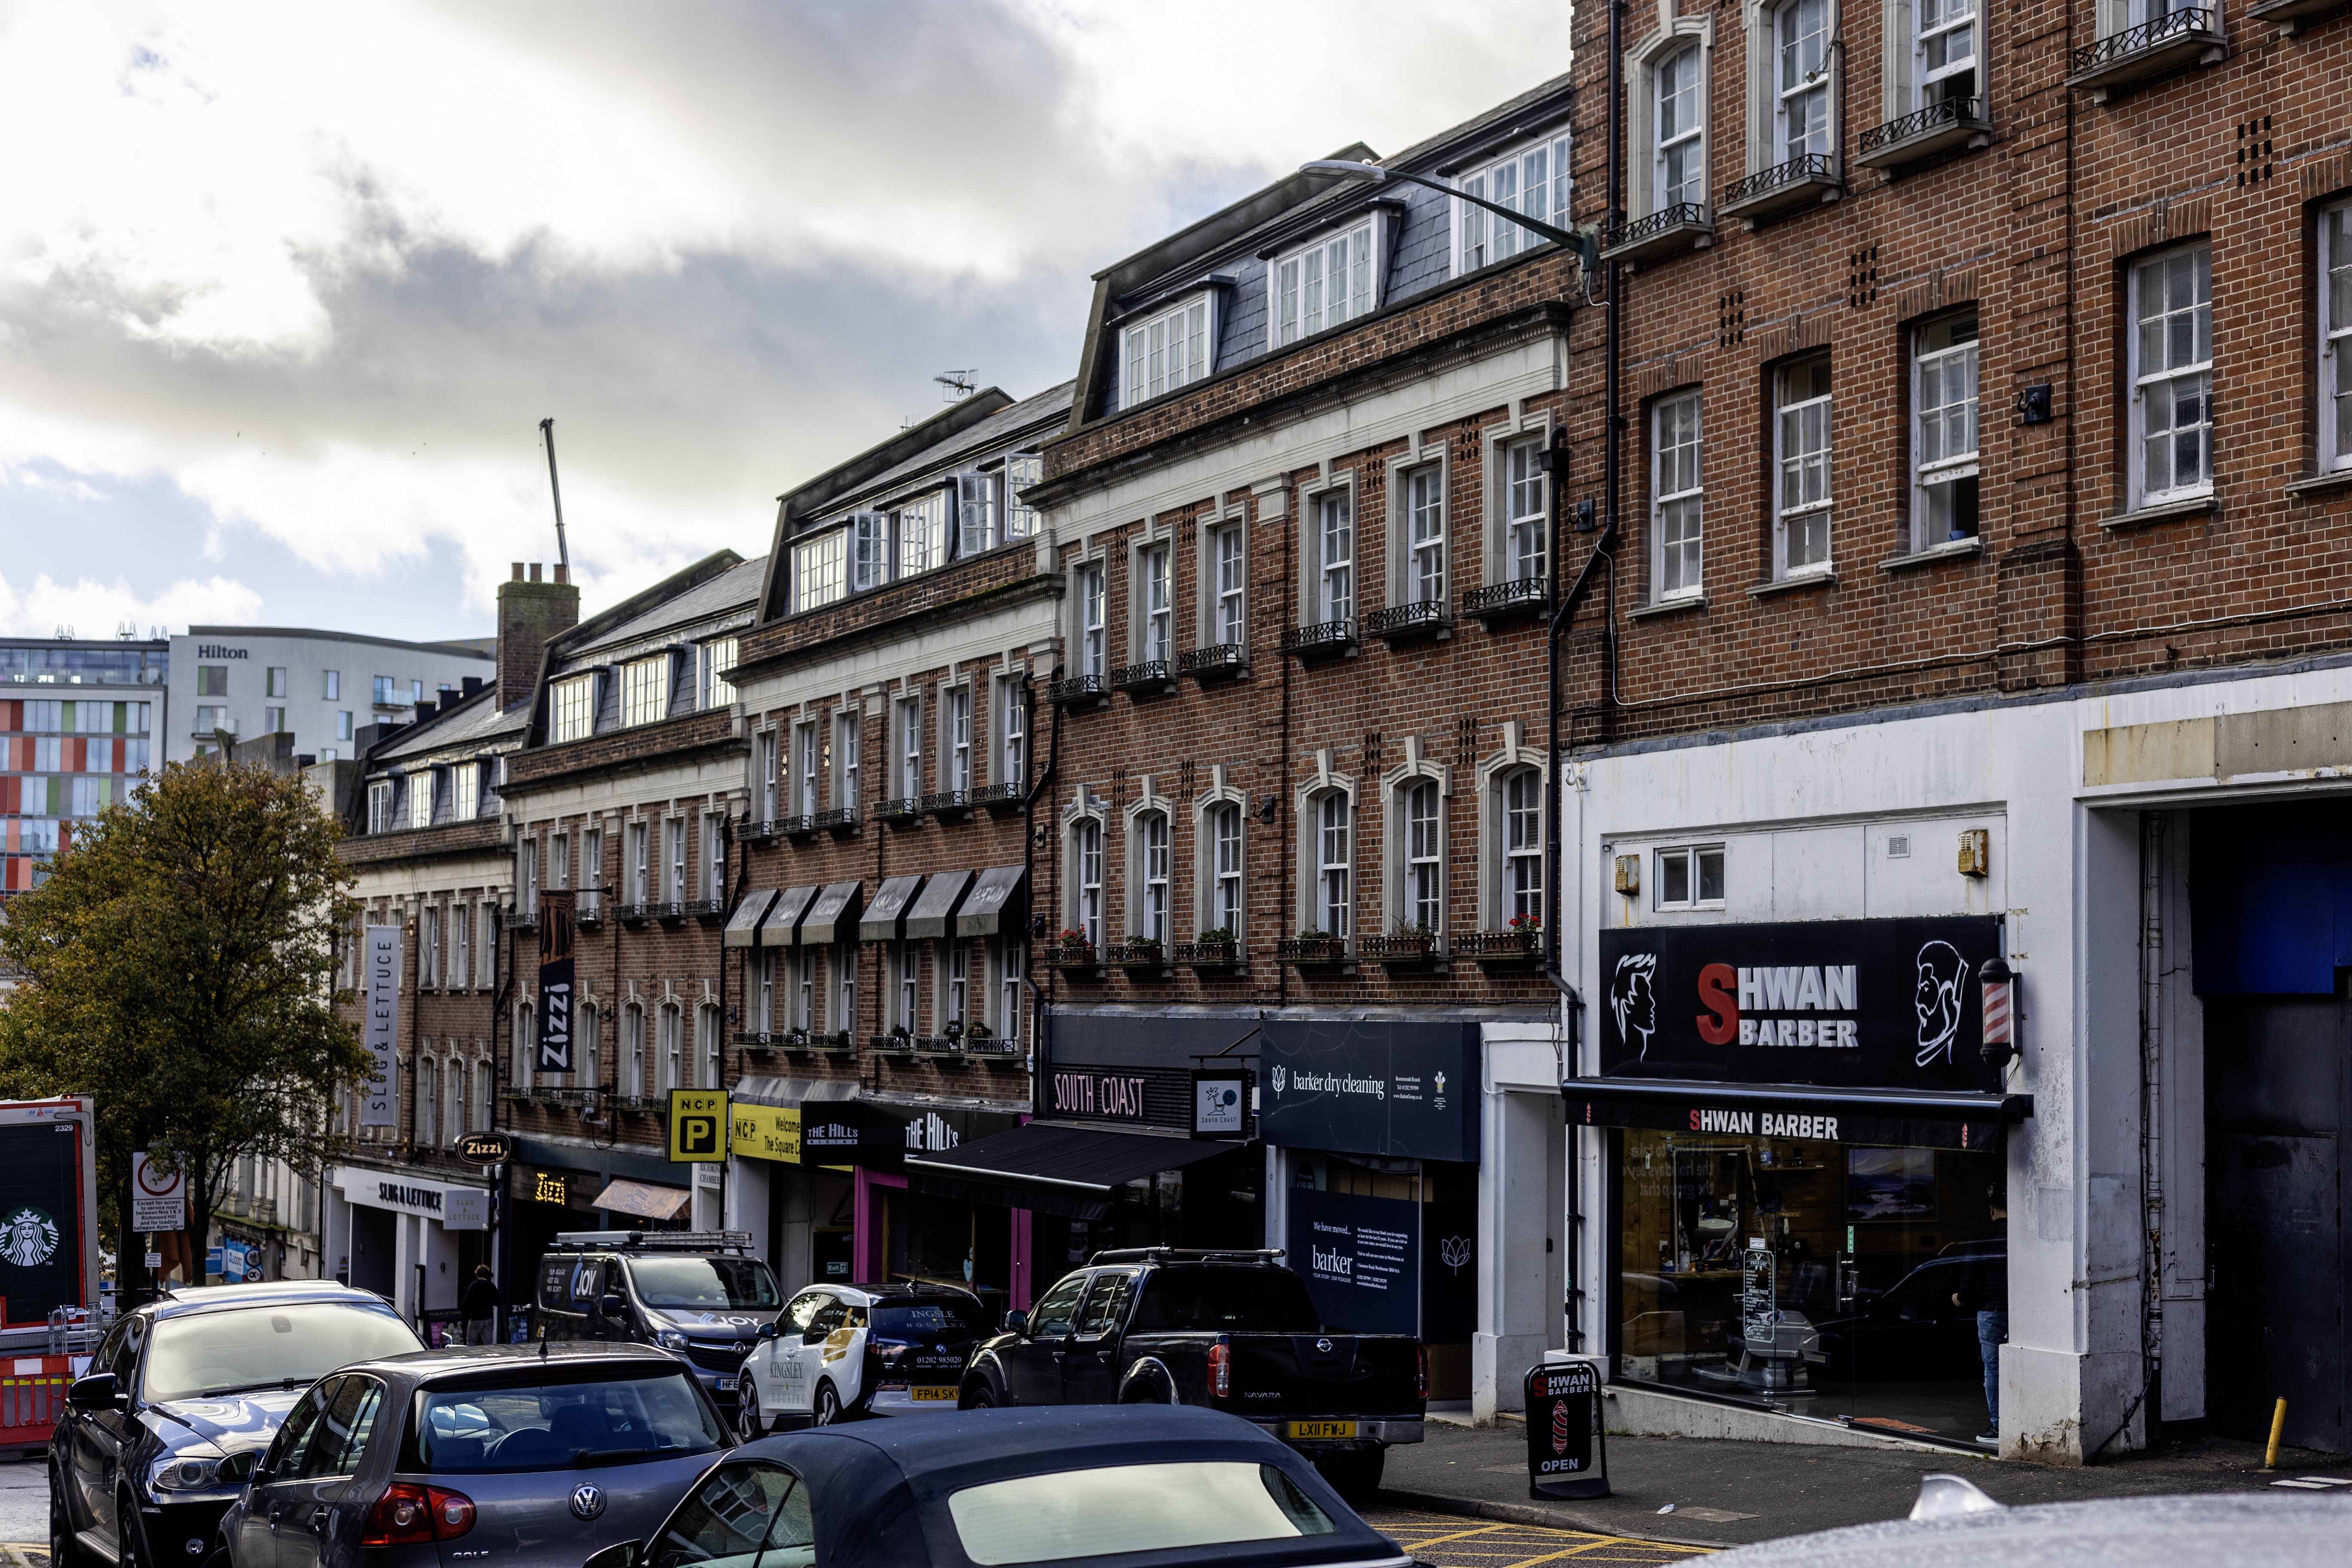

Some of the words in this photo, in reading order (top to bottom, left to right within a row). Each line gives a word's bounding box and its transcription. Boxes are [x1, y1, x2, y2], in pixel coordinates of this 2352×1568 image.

[198, 645, 248, 658] Hilton
[375, 942, 391, 1033] LETTUCE
[1696, 963, 1857, 1045] SHWAN
[542, 983, 570, 1068] Zizzi
[1739, 1019, 1859, 1047] BARBER
[374, 1042, 388, 1050] &
[1294, 1071, 1323, 1090] barker
[1324, 1072, 1342, 1097] dry
[1342, 1073, 1384, 1100] cleaning
[682, 1100, 715, 1109] NCP
[1055, 1074, 1094, 1112] SOUTH
[1102, 1077, 1145, 1117] COAST
[735, 1121, 755, 1139] NCP
[775, 1115, 800, 1133] Welcome
[807, 1126, 825, 1138] THE
[1690, 1109, 1752, 1134] SHWAN
[1761, 1114, 1838, 1140] BARBER
[905, 1118, 923, 1149] THE
[467, 1142, 501, 1154] Zizzi
[765, 1135, 773, 1151] The
[775, 1137, 794, 1158] Square
[379, 1182, 398, 1204] SLUG
[406, 1187, 442, 1213] LETTUCE
[1314, 1222, 1320, 1230] We
[1321, 1222, 1332, 1232] have
[1313, 1244, 1353, 1274] barker
[576, 1269, 597, 1295] JOY
[717, 1316, 759, 1326] JOY
[770, 1362, 803, 1378] KINGSLEY
[917, 1389, 939, 1399] FP14
[1533, 1374, 1589, 1397] SHWAN
[1548, 1385, 1589, 1395] BARBER
[772, 1393, 805, 1404] HOUSING
[1299, 1424, 1320, 1436] LX11
[1323, 1424, 1345, 1435] FWJ
[1541, 1458, 1578, 1472] OPEN
[453, 1551, 489, 1559] GOLF
